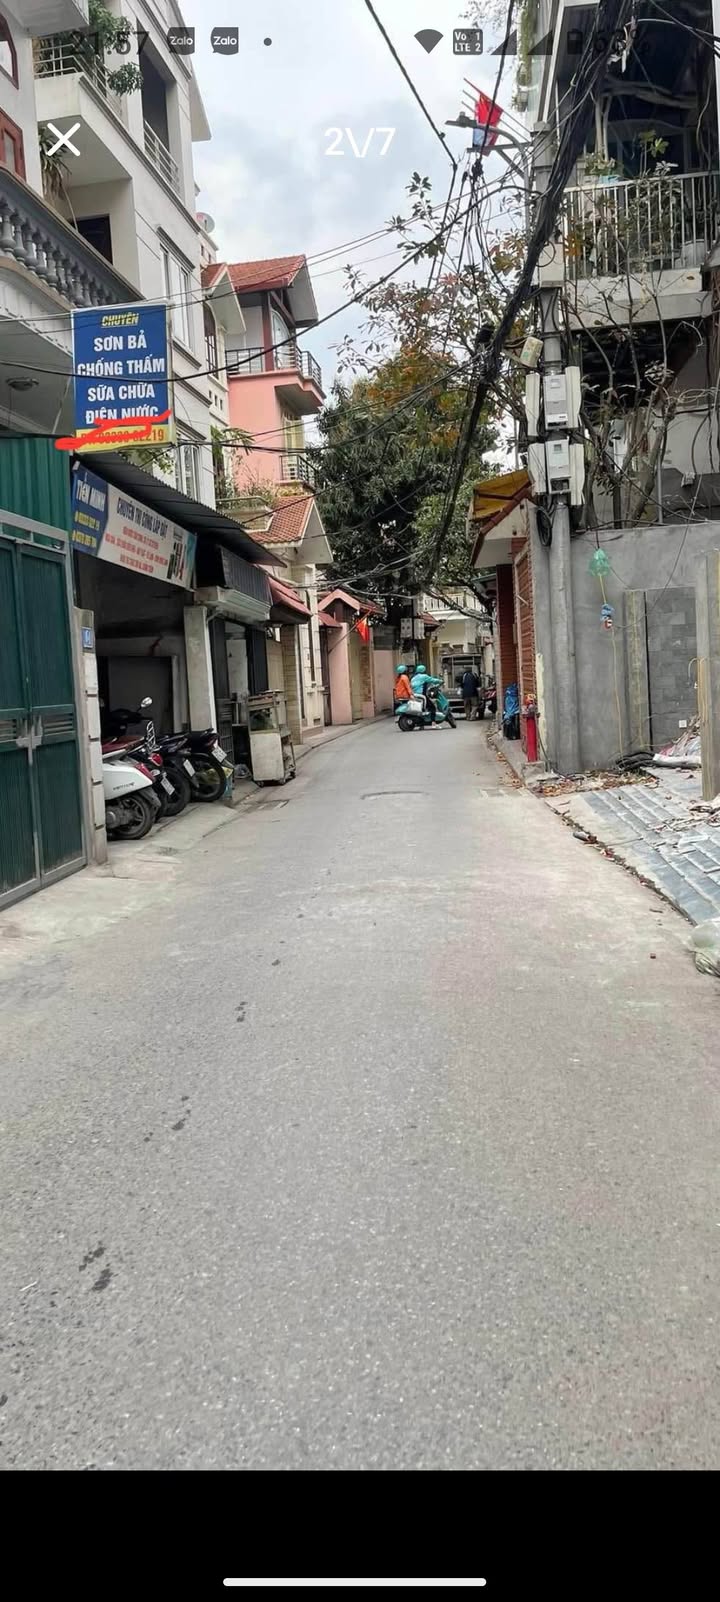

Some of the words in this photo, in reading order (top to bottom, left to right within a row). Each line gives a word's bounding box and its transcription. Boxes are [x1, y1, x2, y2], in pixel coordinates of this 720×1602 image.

[101, 311, 139, 327] CHUYÊN
[93, 335, 123, 352] SƠN
[127, 329, 147, 350] BẢ
[77, 357, 123, 376] CHỐNG
[126, 353, 165, 374] THẤM
[118, 381, 155, 399] CHỮA
